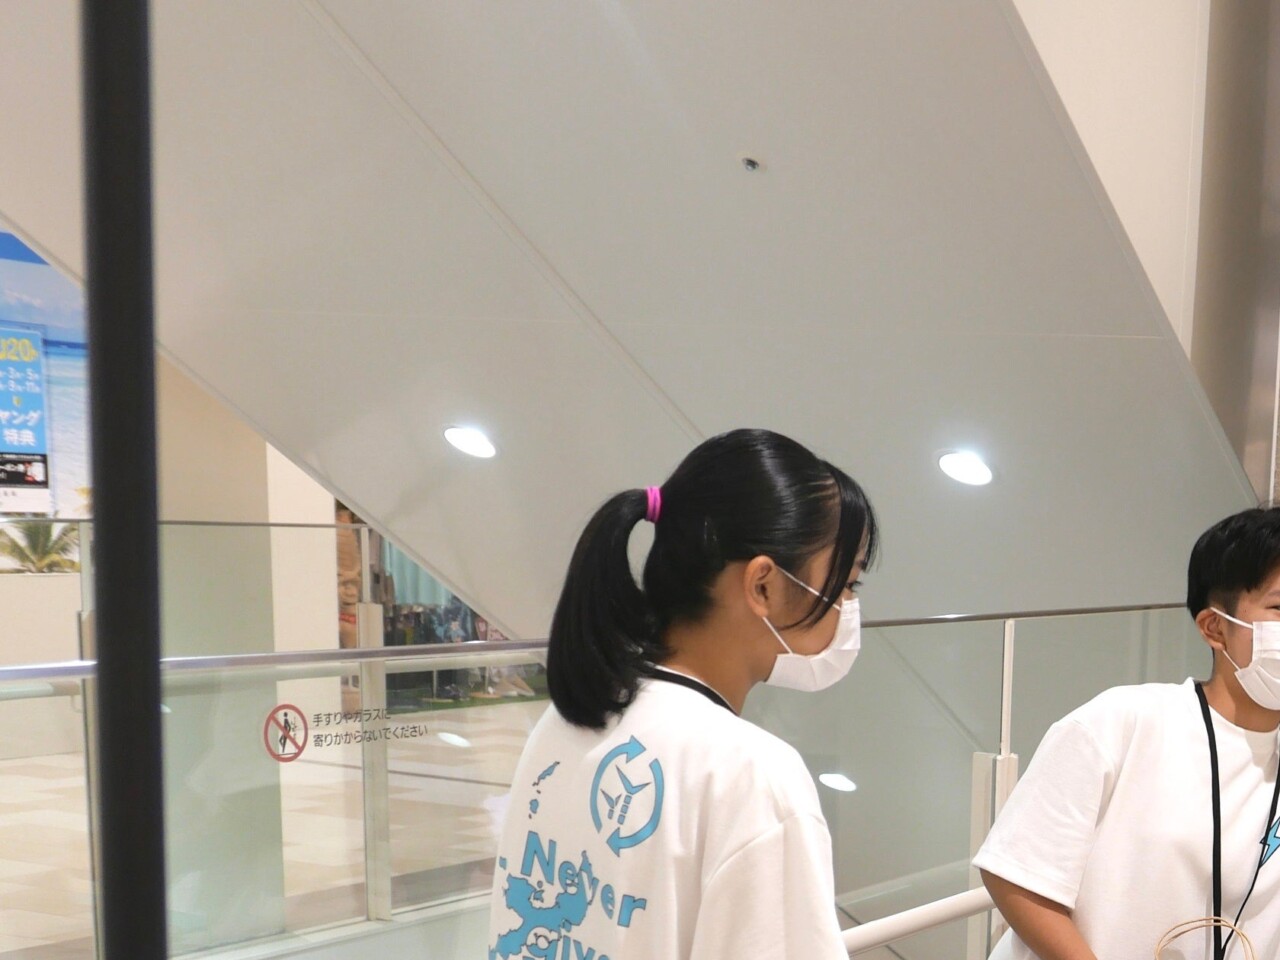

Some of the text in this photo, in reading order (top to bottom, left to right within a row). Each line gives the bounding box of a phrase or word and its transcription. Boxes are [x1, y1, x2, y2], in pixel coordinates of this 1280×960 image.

[312, 708, 392, 727] 手すりやガラスに
[312, 724, 428, 748] 寄りかからないでください
[520, 830, 648, 928] Never
